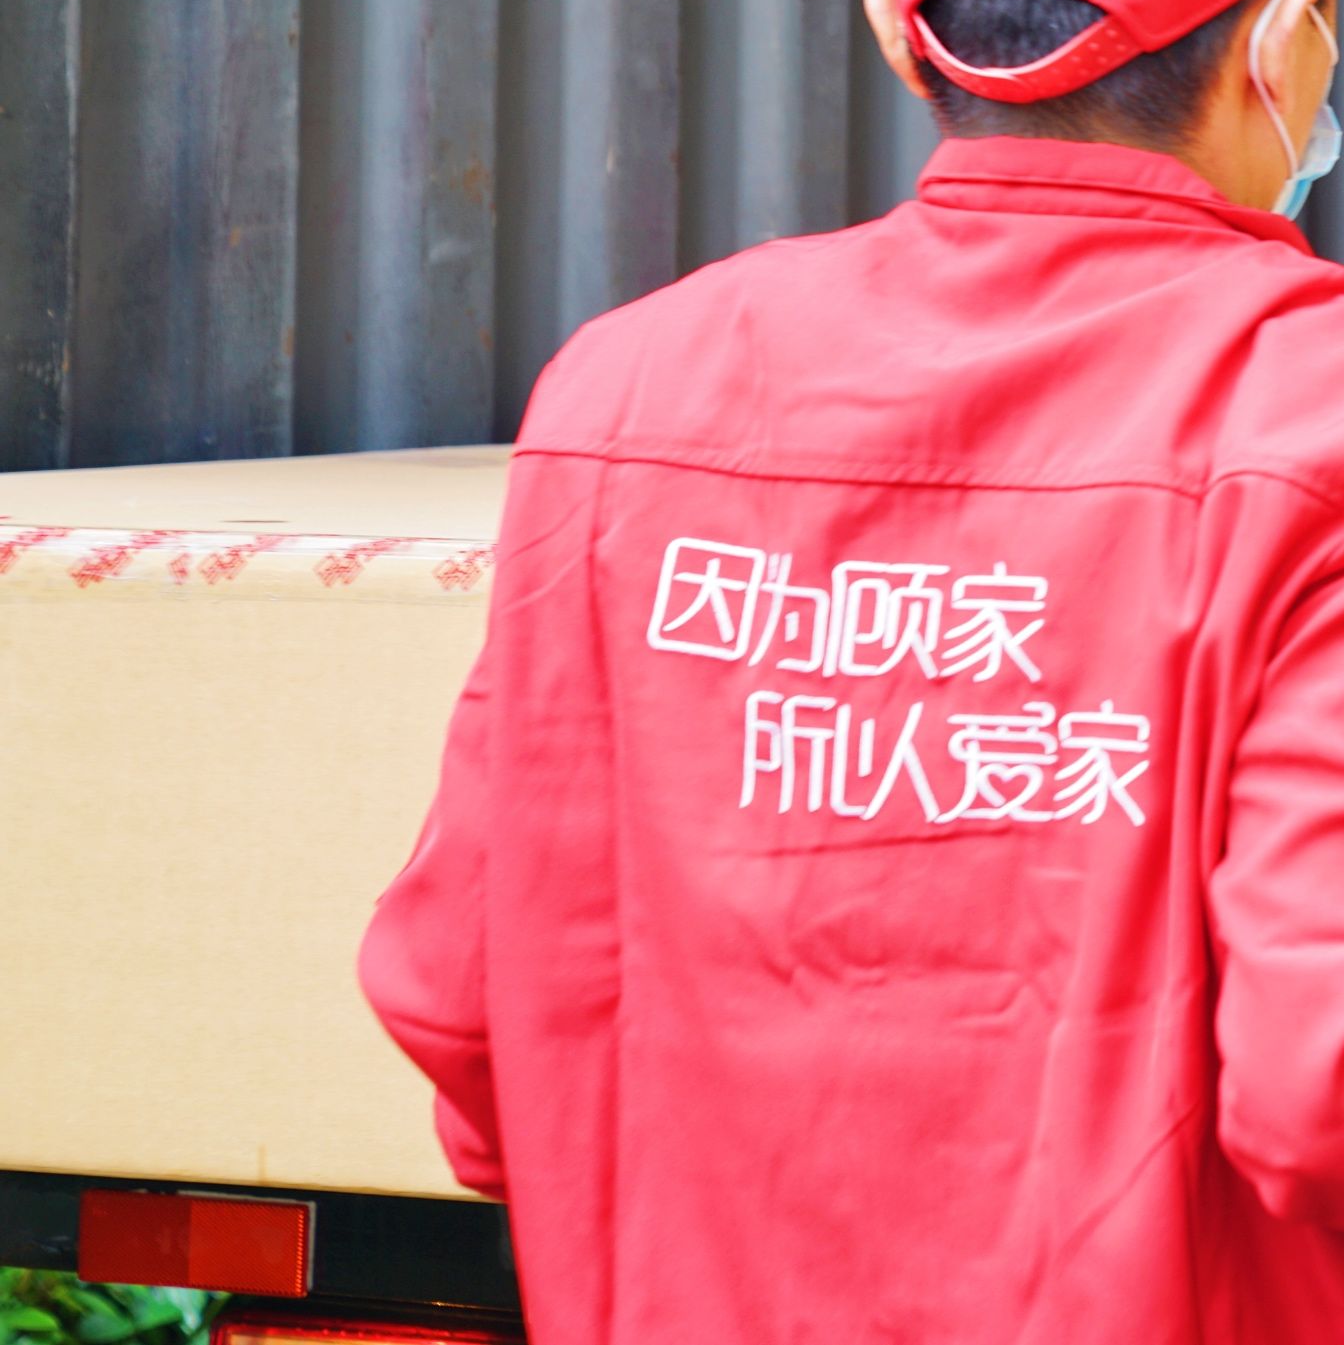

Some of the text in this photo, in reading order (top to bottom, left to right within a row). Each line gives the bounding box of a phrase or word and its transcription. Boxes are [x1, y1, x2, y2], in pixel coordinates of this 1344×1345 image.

[647, 536, 1050, 683] 因为顾家
[738, 689, 1152, 827] 所以爱家
